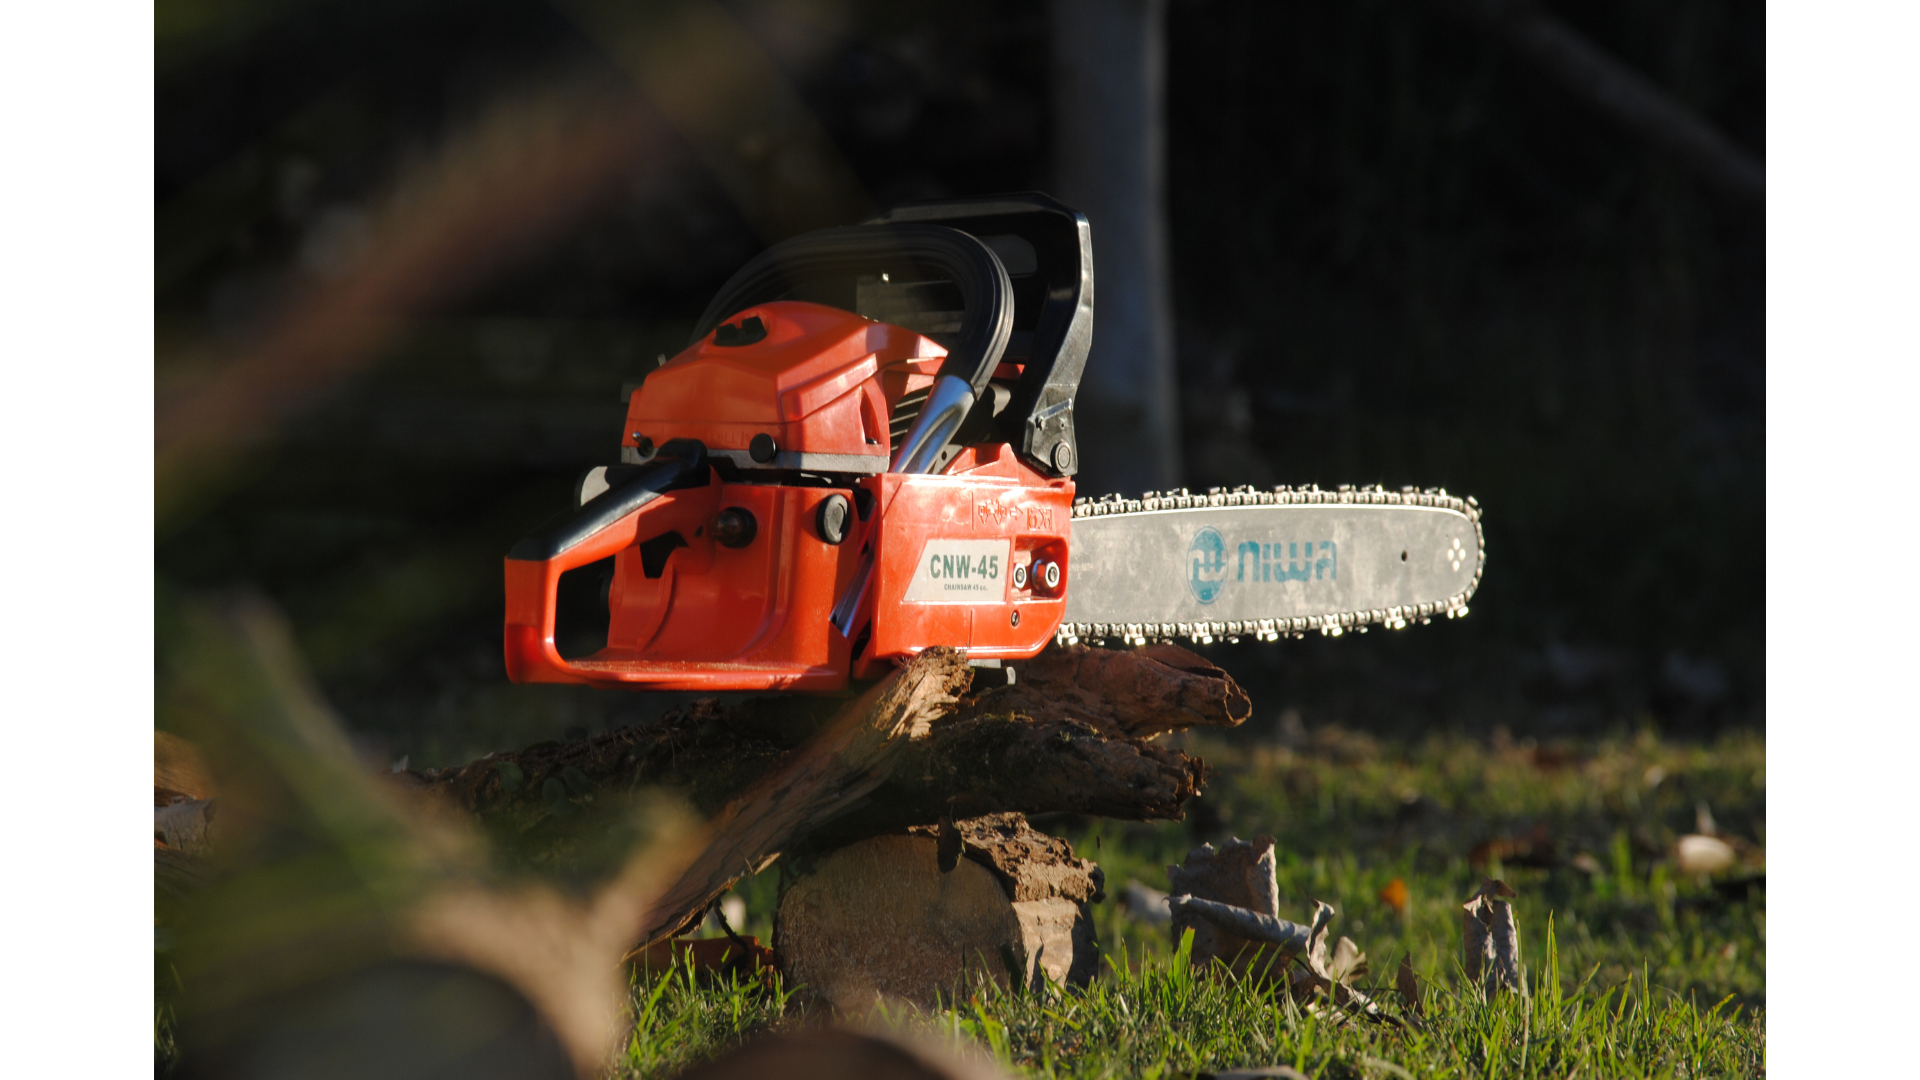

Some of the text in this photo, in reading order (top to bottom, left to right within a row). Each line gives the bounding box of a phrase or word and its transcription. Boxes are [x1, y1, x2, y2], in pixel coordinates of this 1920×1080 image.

[930, 554, 998, 579] CNW-45
[1238, 541, 1337, 583] niwa
[943, 583, 972, 591] CHAINSAW
[972, 583, 979, 591] 45
